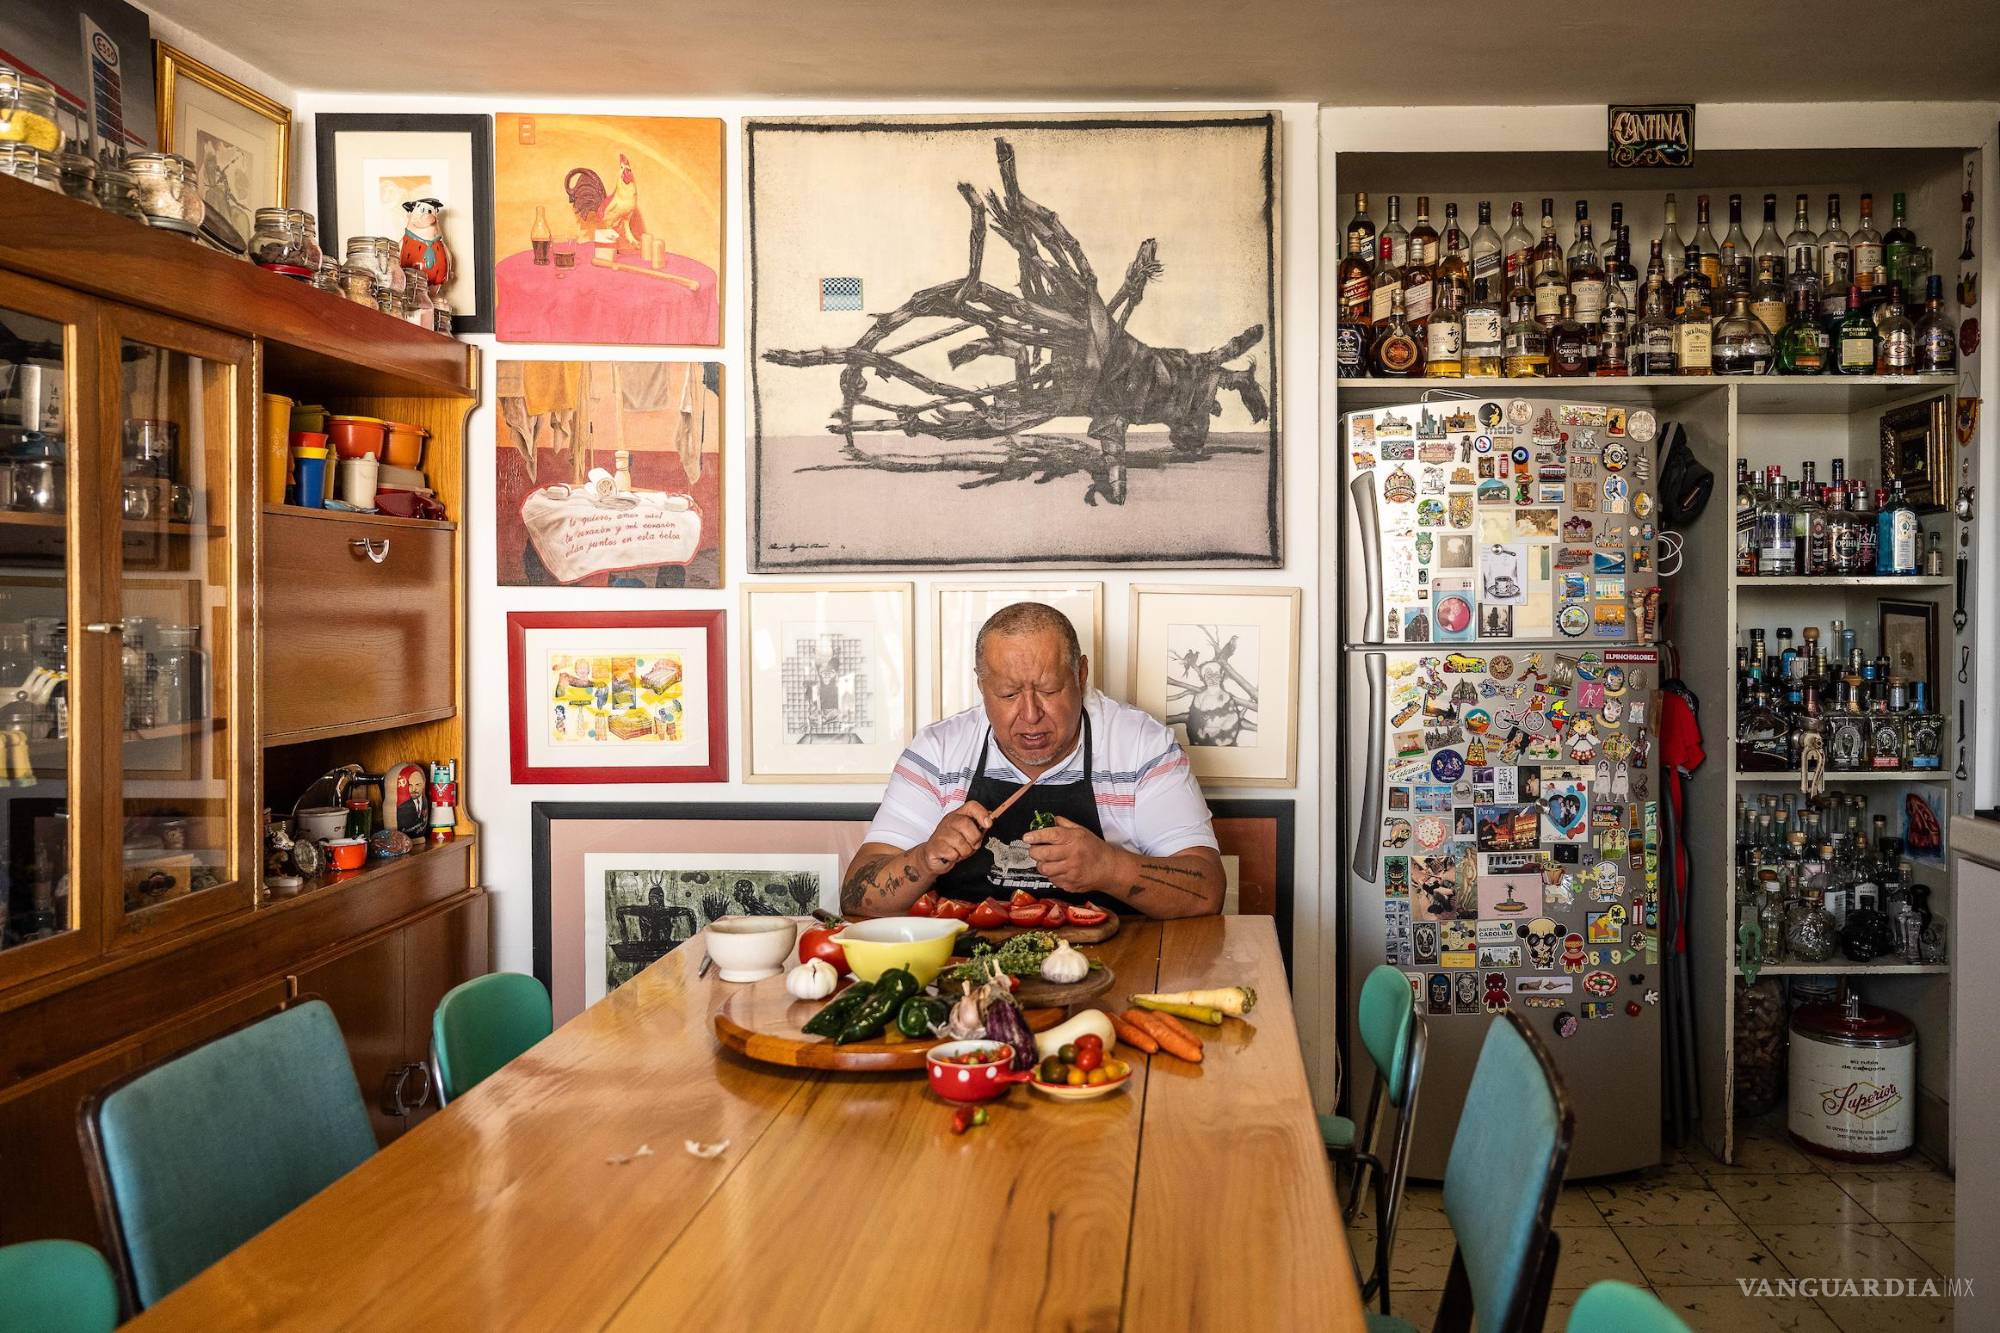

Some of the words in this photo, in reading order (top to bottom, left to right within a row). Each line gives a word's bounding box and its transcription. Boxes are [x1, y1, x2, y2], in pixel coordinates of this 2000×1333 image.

[1613, 112, 1688, 146] CANTINA
[1570, 455, 1597, 464] BERLIN
[621, 536, 632, 544] en
[1479, 930, 1513, 938] CAROLINA
[1823, 1083, 1897, 1115] Superior
